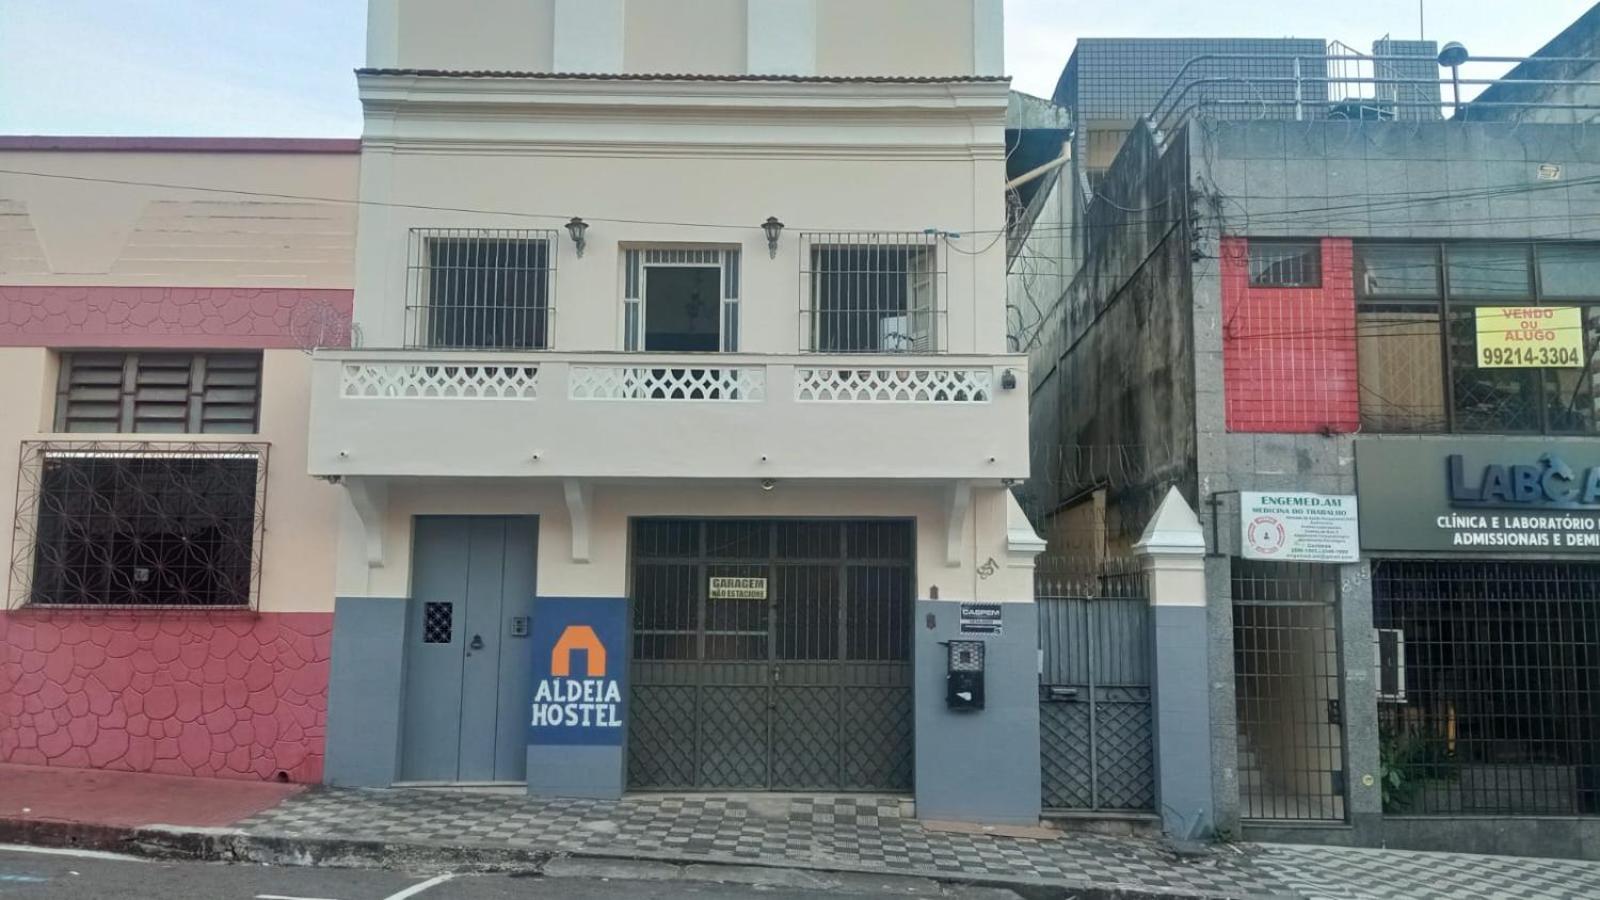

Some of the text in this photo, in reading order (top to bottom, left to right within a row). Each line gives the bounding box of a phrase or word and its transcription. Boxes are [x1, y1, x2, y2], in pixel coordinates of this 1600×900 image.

[1503, 309, 1554, 319] VENDO
[1520, 321, 1538, 329] OU
[1504, 330, 1556, 341] ALUGO
[1483, 347, 1579, 365] 99214-3304
[1261, 496, 1342, 507] ENGEMED.AM
[1437, 513, 1487, 528] CLÍNICA
[1491, 516, 1500, 529] E
[1504, 513, 1594, 530] LABORATÓRIO
[1453, 532, 1549, 545] ADMISSIONAIS
[1553, 533, 1561, 546] E
[712, 578, 764, 588] GARAGEM
[712, 589, 764, 598] NÃO ESTACIONE
[534, 678, 621, 702] ALDEIA
[531, 703, 622, 727] HOSTEL
